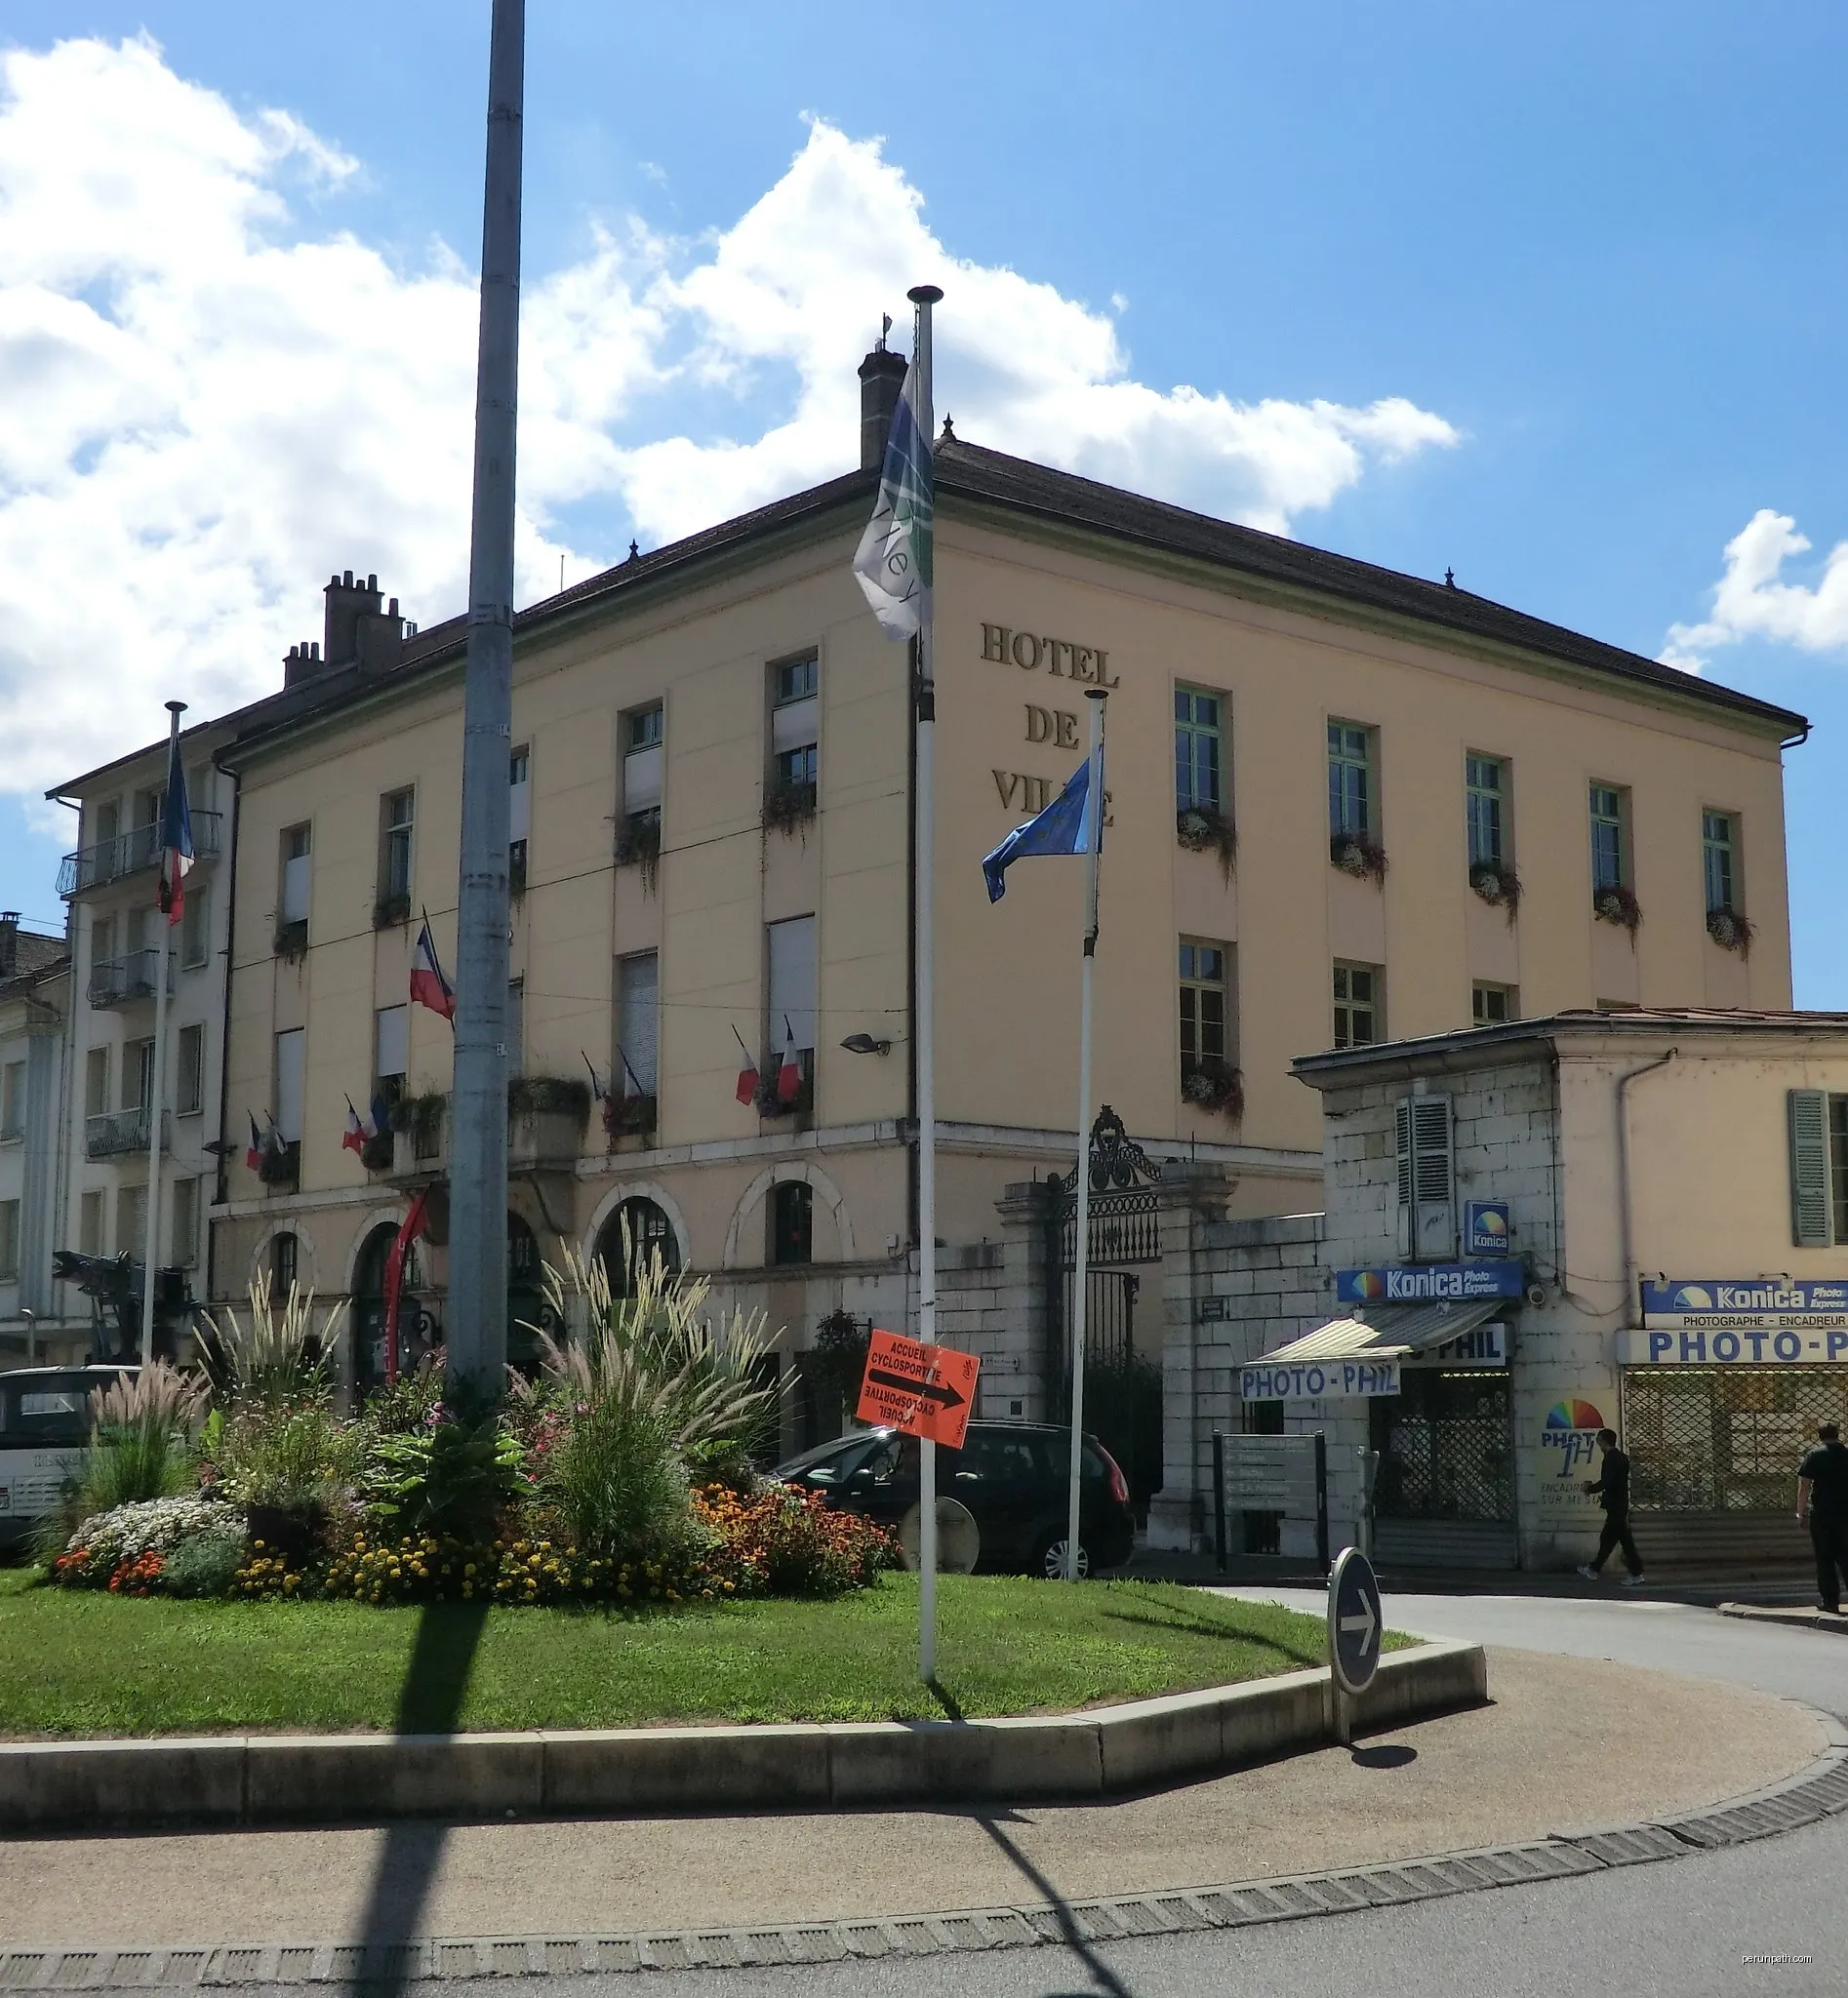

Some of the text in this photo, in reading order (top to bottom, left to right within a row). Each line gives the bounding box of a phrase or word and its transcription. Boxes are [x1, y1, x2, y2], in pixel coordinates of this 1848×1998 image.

[980, 622, 1120, 689] HOTEL
[1024, 703, 1080, 749] DE
[991, 769, 1114, 827] VIL
[1473, 1234, 1507, 1249] Konica
[1386, 1268, 1491, 1299] Konica Photo
[1464, 1283, 1499, 1295] Express
[1716, 1285, 1843, 1308] Konica Photo
[1810, 1299, 1846, 1309] Express
[1683, 1316, 1764, 1327] PHOTOGRAPHE
[1779, 1315, 1846, 1326] ENCADREUR
[890, 1341, 927, 1362] ACCUEIL
[864, 1385, 936, 1417] CYCLOSPORTIVE
[879, 1405, 916, 1425] ACCUEIL
[1542, 1432, 1596, 1448] PHOT
[1541, 1495, 1601, 1505] SUR MESU
